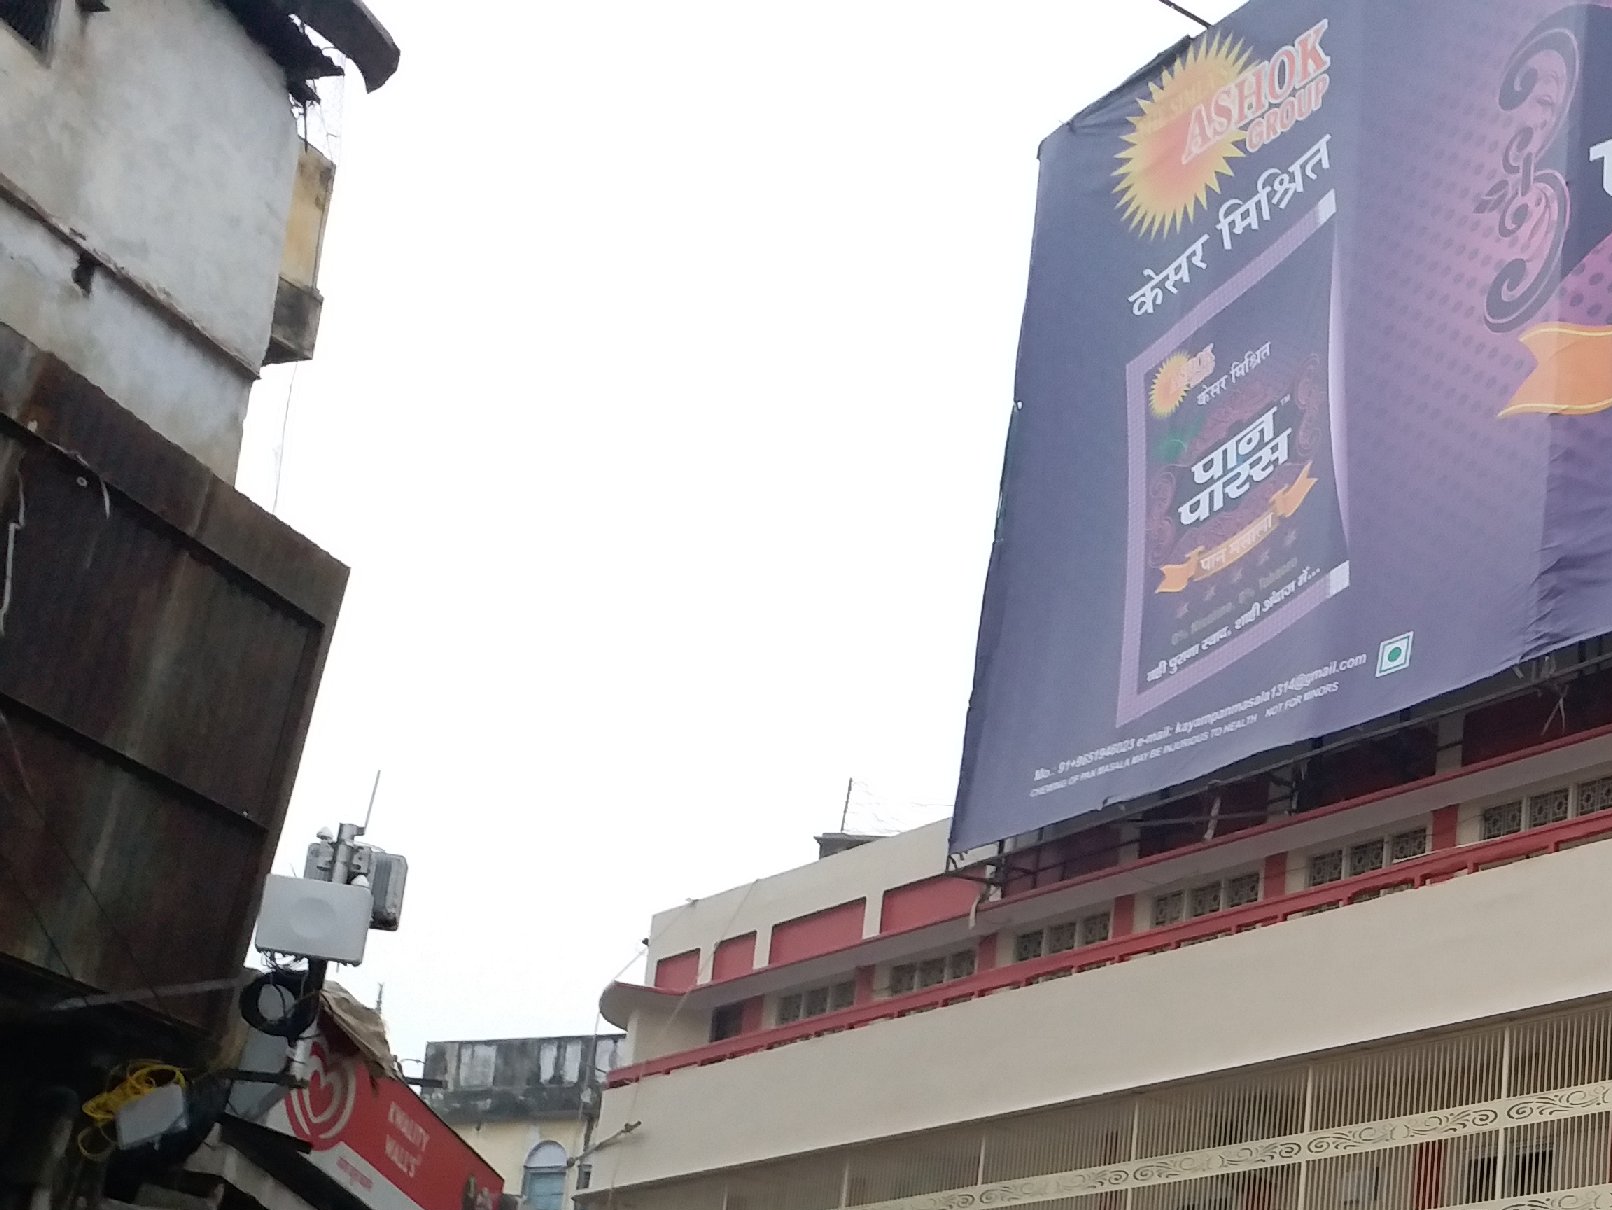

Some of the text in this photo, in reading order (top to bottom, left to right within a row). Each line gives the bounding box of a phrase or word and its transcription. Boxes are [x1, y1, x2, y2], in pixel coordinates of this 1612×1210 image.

[1181, 18, 1331, 165] ASHOK
[1245, 73, 1331, 153] GROUP
[1128, 133, 1332, 316] केसर मिश्रित
[1177, 427, 1293, 525] पारस
[1191, 405, 1278, 484] पान
[1265, 703, 1283, 718] NOT
[1284, 695, 1302, 711] FOR
